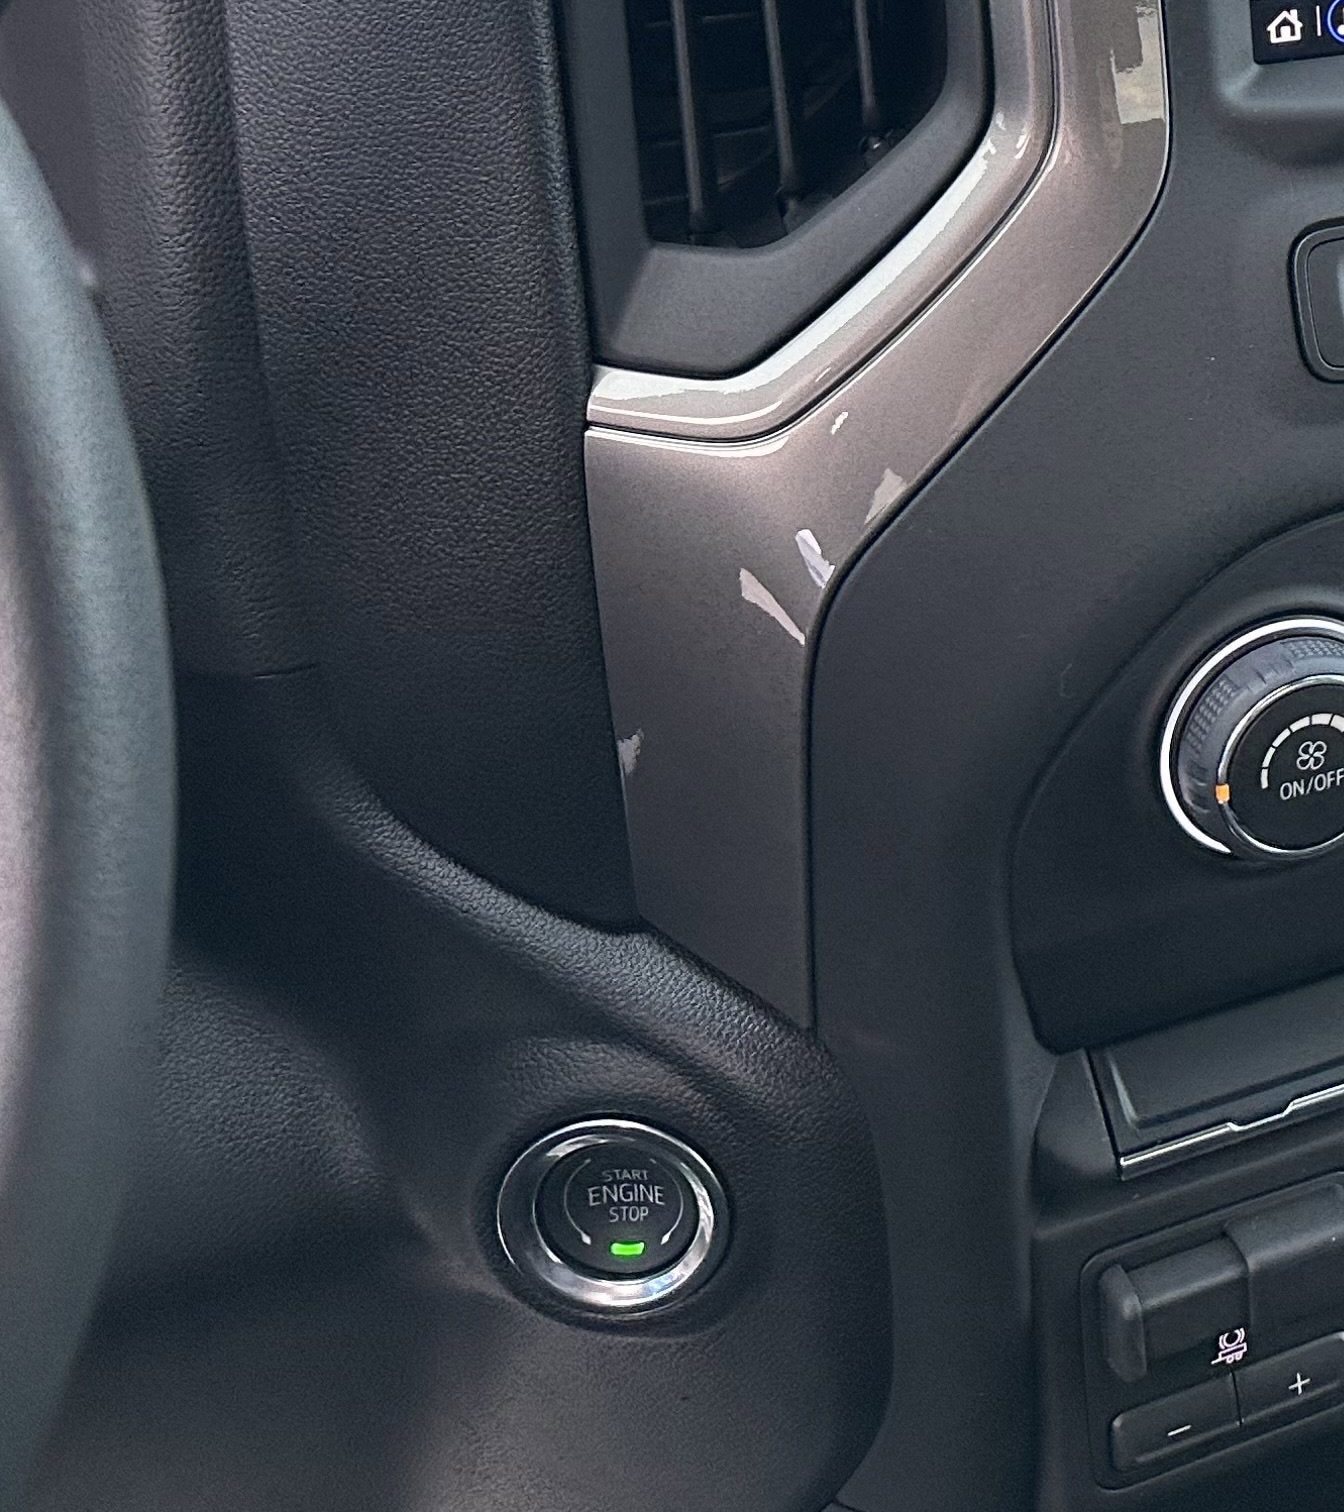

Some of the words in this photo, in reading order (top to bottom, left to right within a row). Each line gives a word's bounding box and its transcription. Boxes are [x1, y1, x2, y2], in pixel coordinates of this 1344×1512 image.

[602, 1169, 648, 1181] START
[588, 1183, 665, 1206] ENGINE
[609, 1206, 649, 1223] STOP
